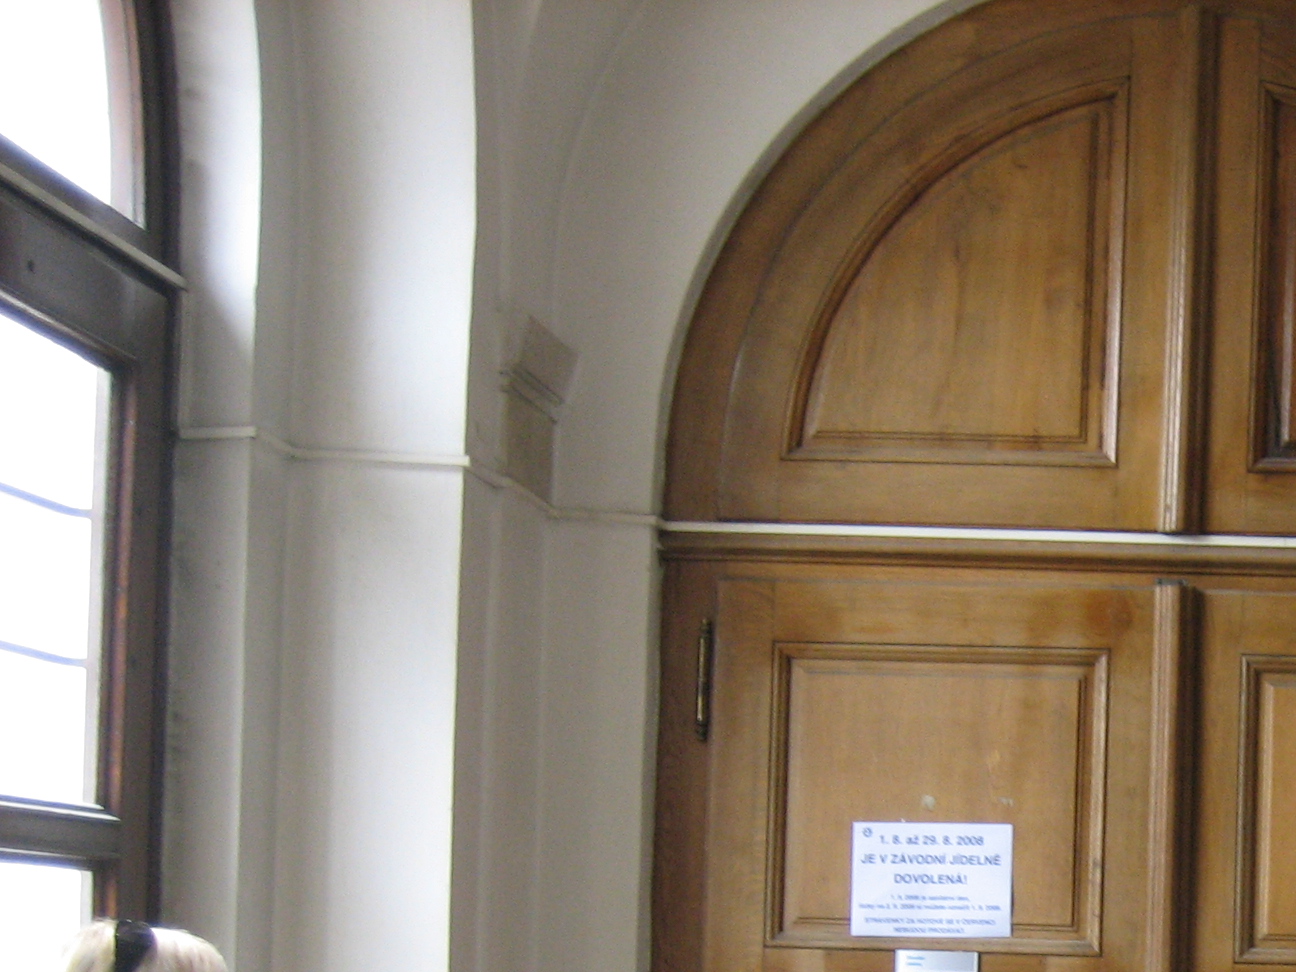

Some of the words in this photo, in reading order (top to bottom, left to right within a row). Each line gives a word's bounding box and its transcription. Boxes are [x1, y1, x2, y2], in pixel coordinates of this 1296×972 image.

[956, 836, 985, 846] 2008
[860, 853, 876, 864] JE
[879, 854, 888, 864] V
